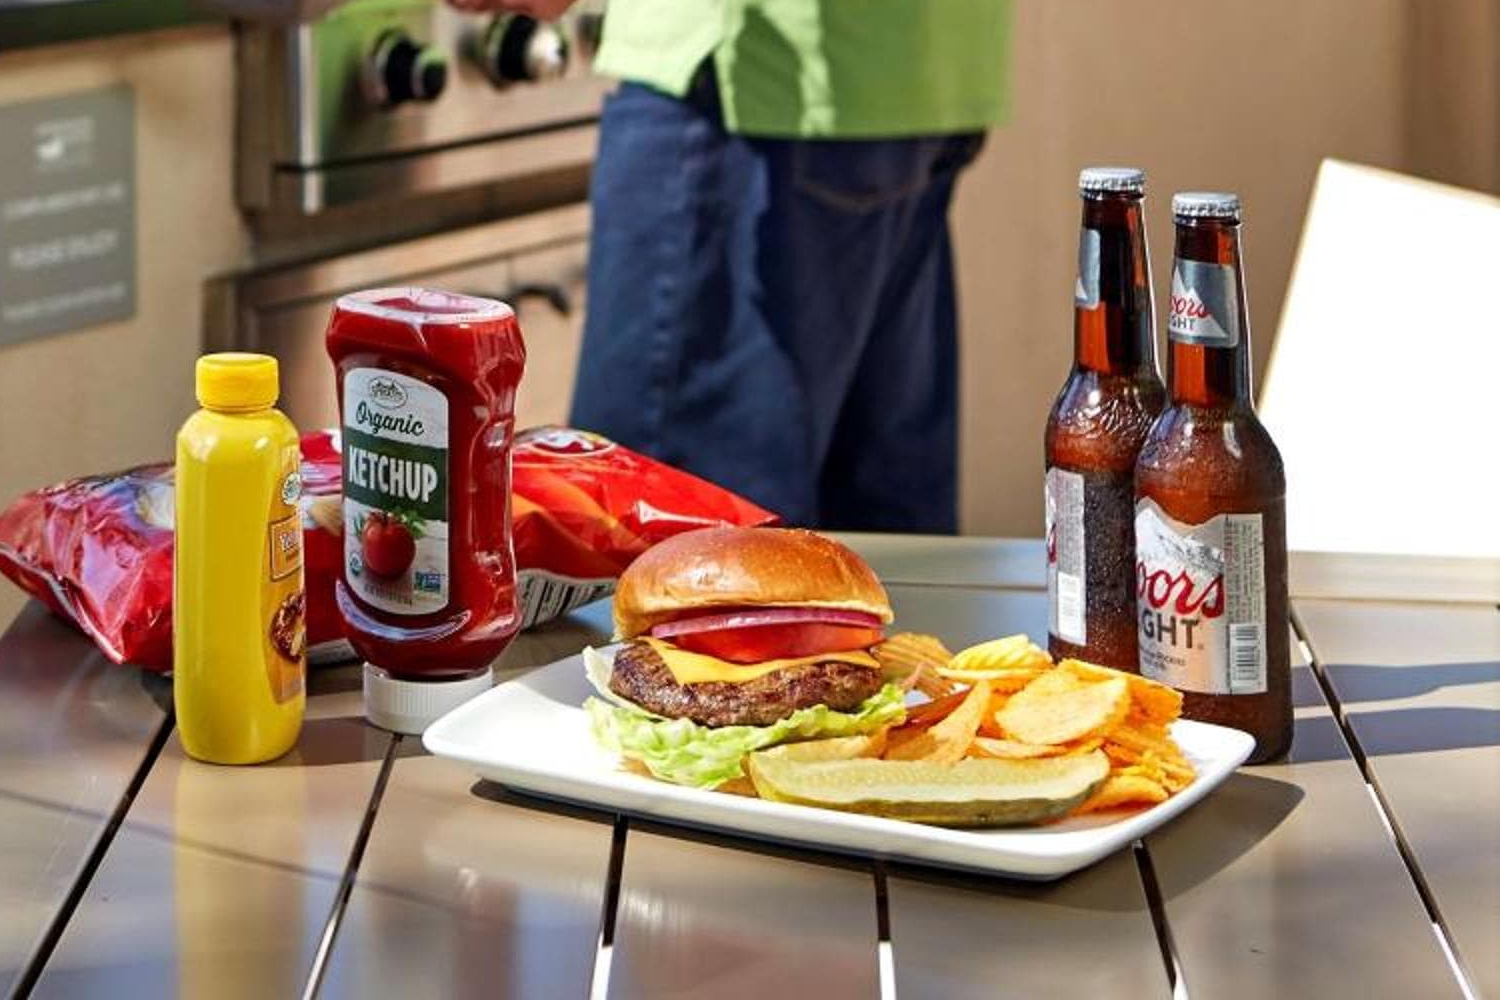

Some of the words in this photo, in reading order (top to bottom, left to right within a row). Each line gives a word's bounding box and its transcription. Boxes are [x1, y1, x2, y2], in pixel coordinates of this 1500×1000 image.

[1171, 295, 1213, 319] oors
[1171, 313, 1197, 331] GHT
[356, 400, 424, 434] Organic
[349, 444, 438, 503] KETCHUP
[1137, 561, 1225, 619] oors
[1141, 607, 1200, 649] GHT
